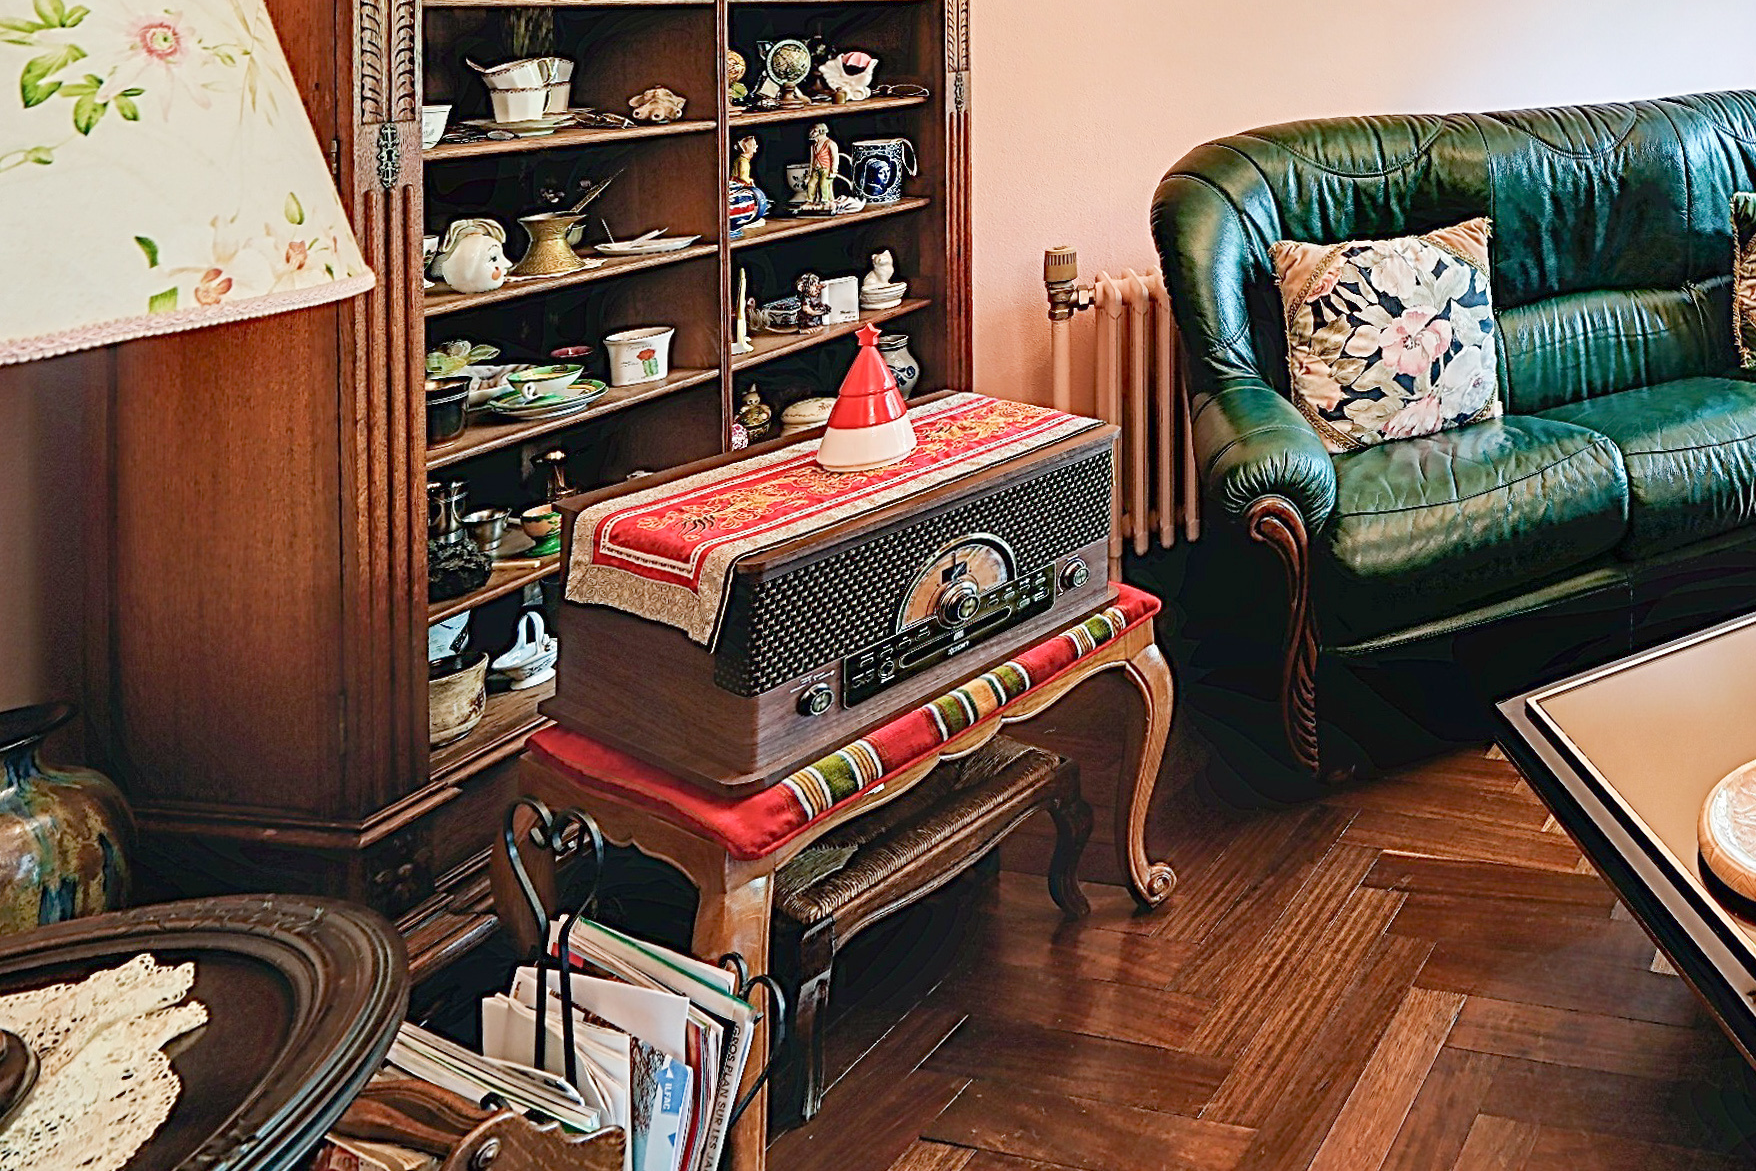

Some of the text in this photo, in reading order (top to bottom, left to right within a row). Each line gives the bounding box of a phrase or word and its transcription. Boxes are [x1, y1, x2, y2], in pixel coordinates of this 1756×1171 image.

[703, 1024, 741, 1171] GROS PLAN SUR LES JA
